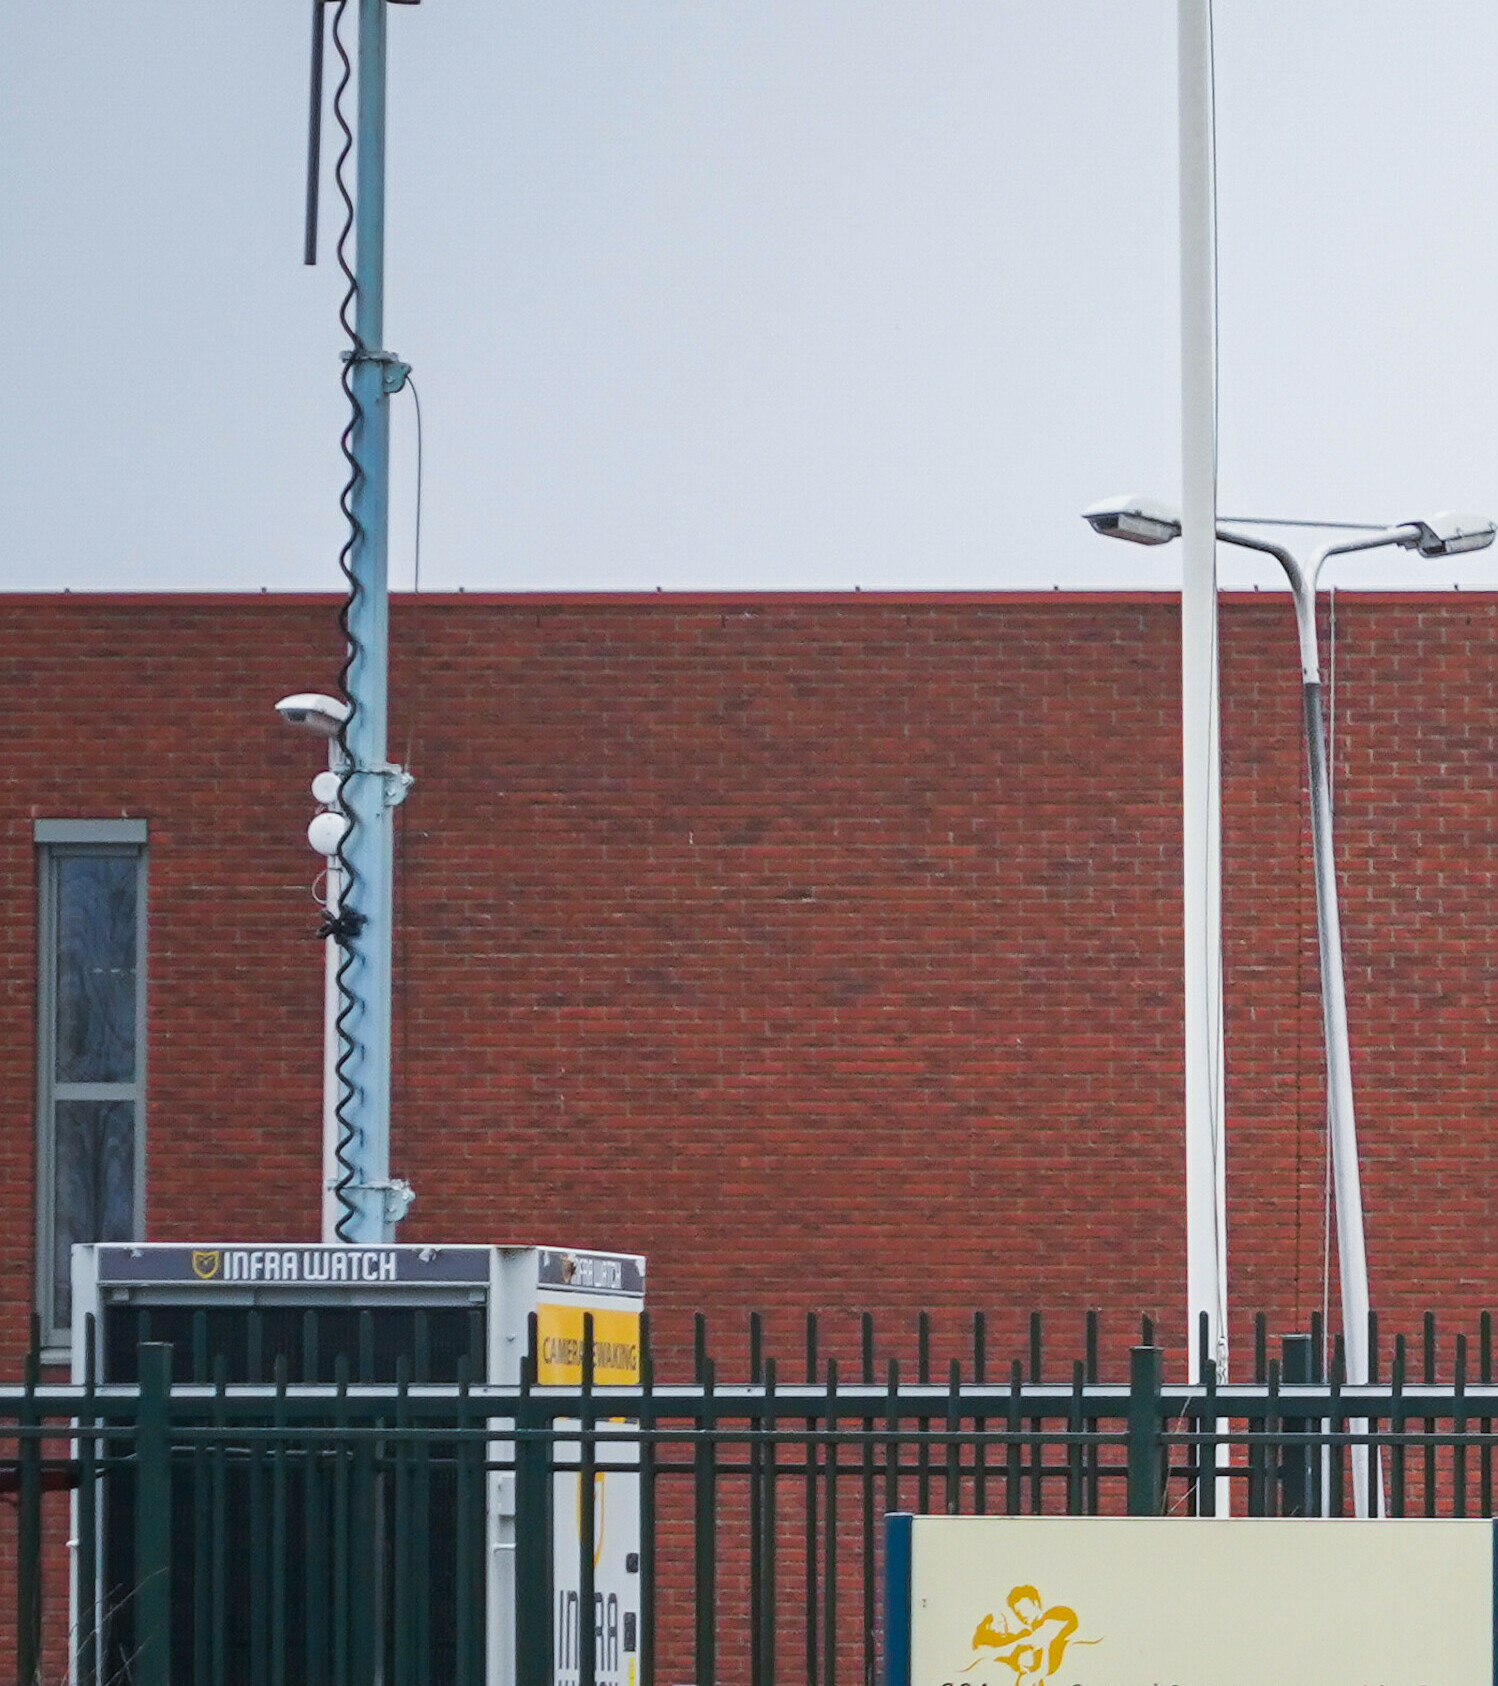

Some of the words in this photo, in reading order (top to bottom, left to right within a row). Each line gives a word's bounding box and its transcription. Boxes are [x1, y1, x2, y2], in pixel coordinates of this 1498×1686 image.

[223, 1251, 298, 1281] INFRA
[303, 1251, 397, 1281] WATCH
[558, 1589, 618, 1672] INRA
